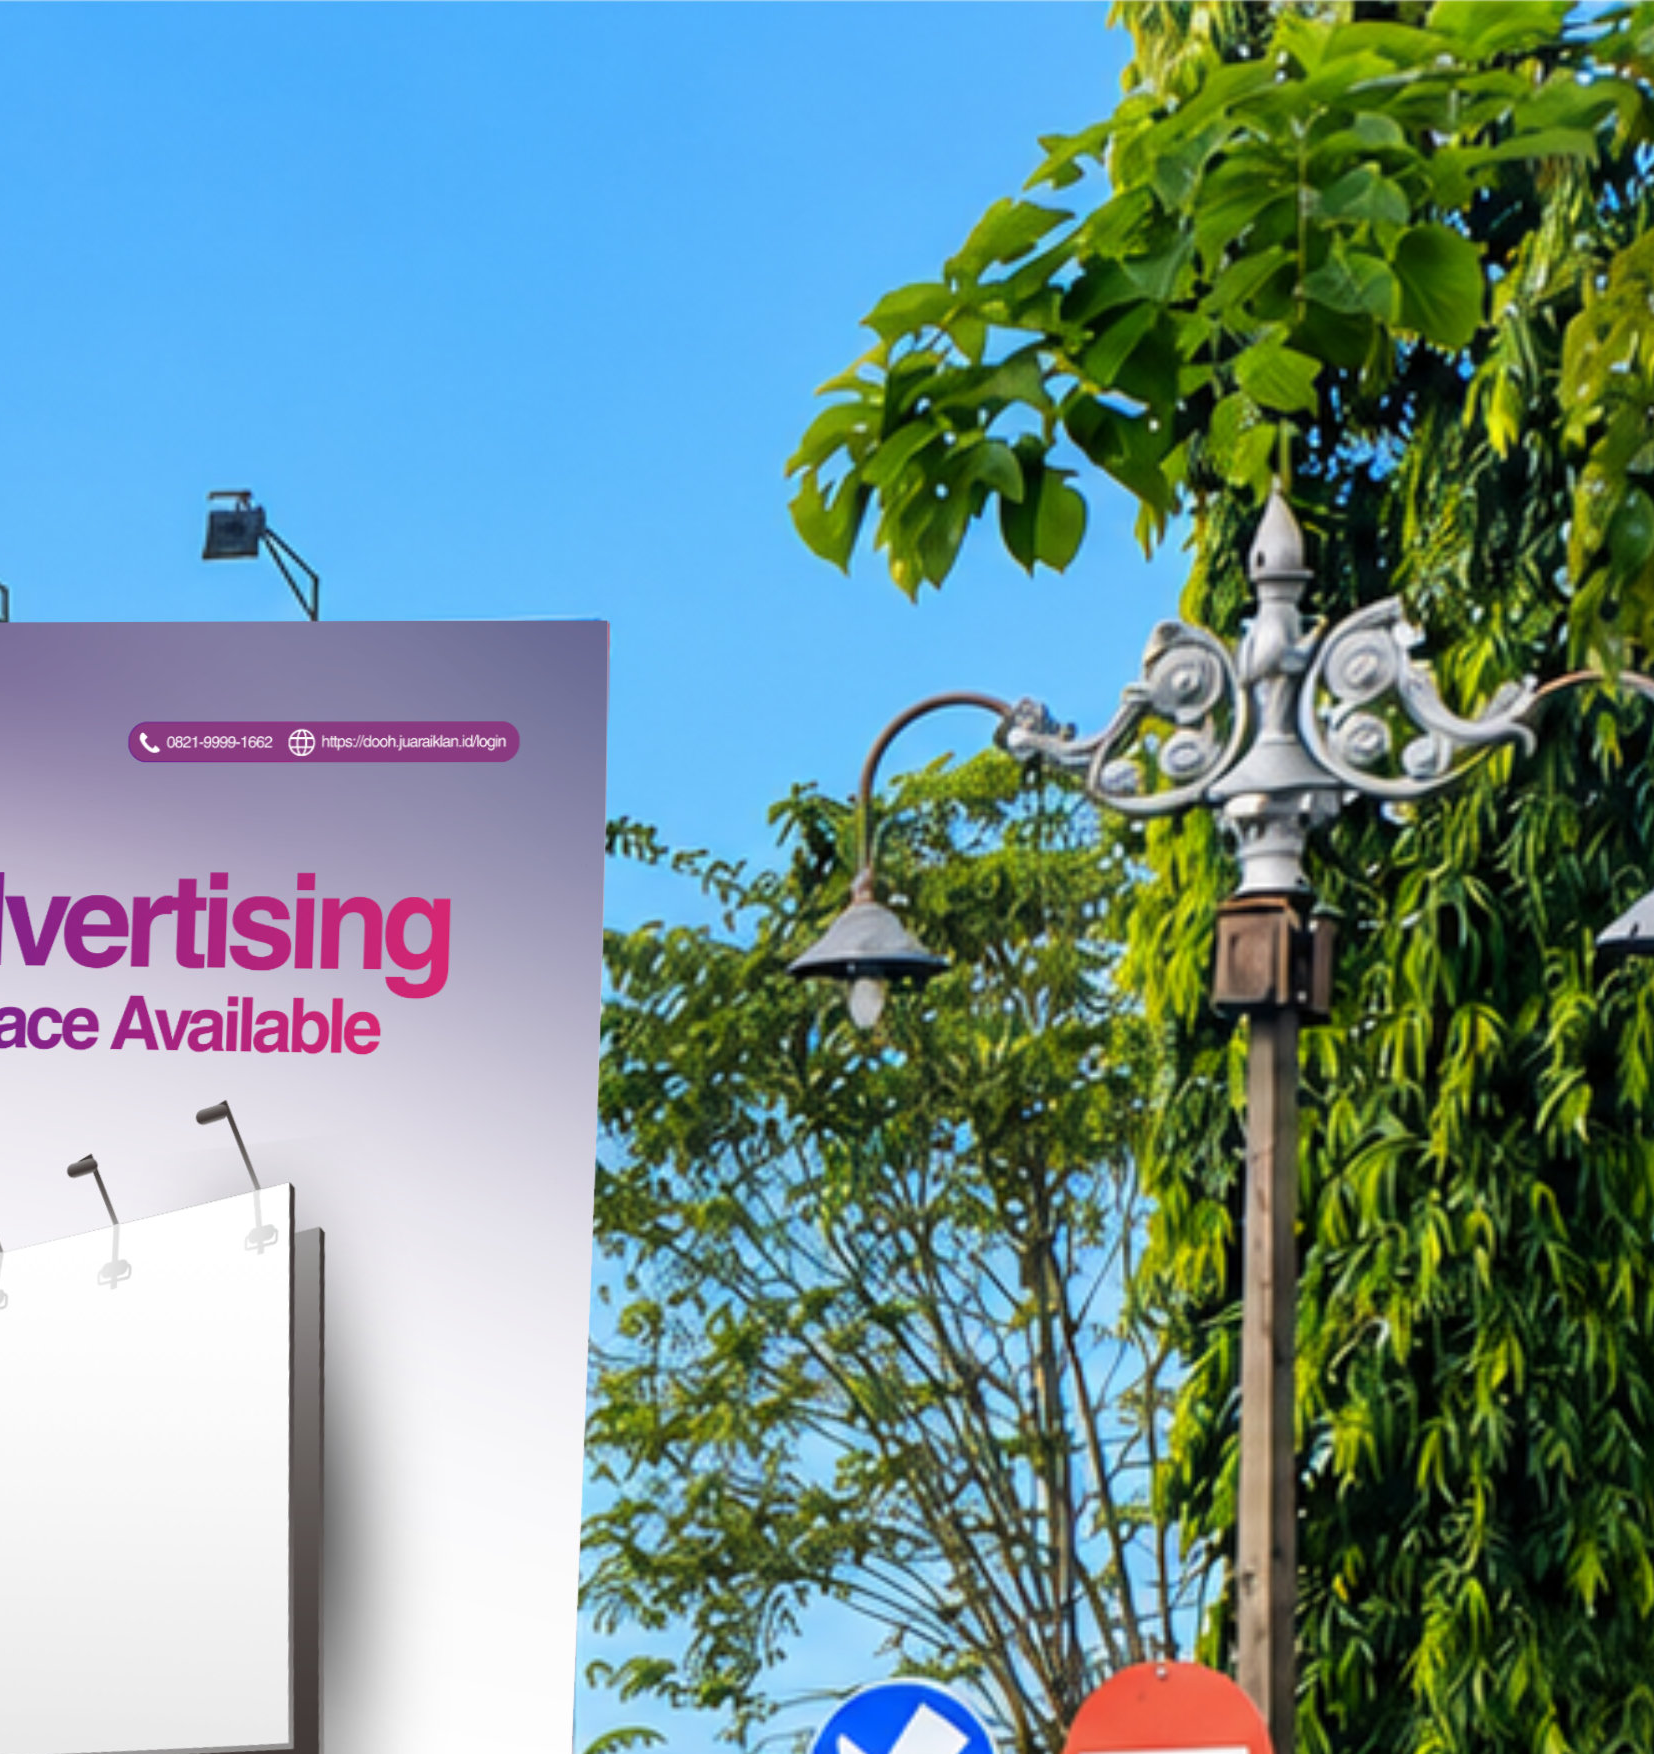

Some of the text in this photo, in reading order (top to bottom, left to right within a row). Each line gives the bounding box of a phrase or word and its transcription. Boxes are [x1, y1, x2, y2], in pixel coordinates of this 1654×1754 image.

[166, 734, 506, 751] 0821-9999-1662 https://dooh.juaraiklan.id/login
[110, 996, 381, 1056] Available
